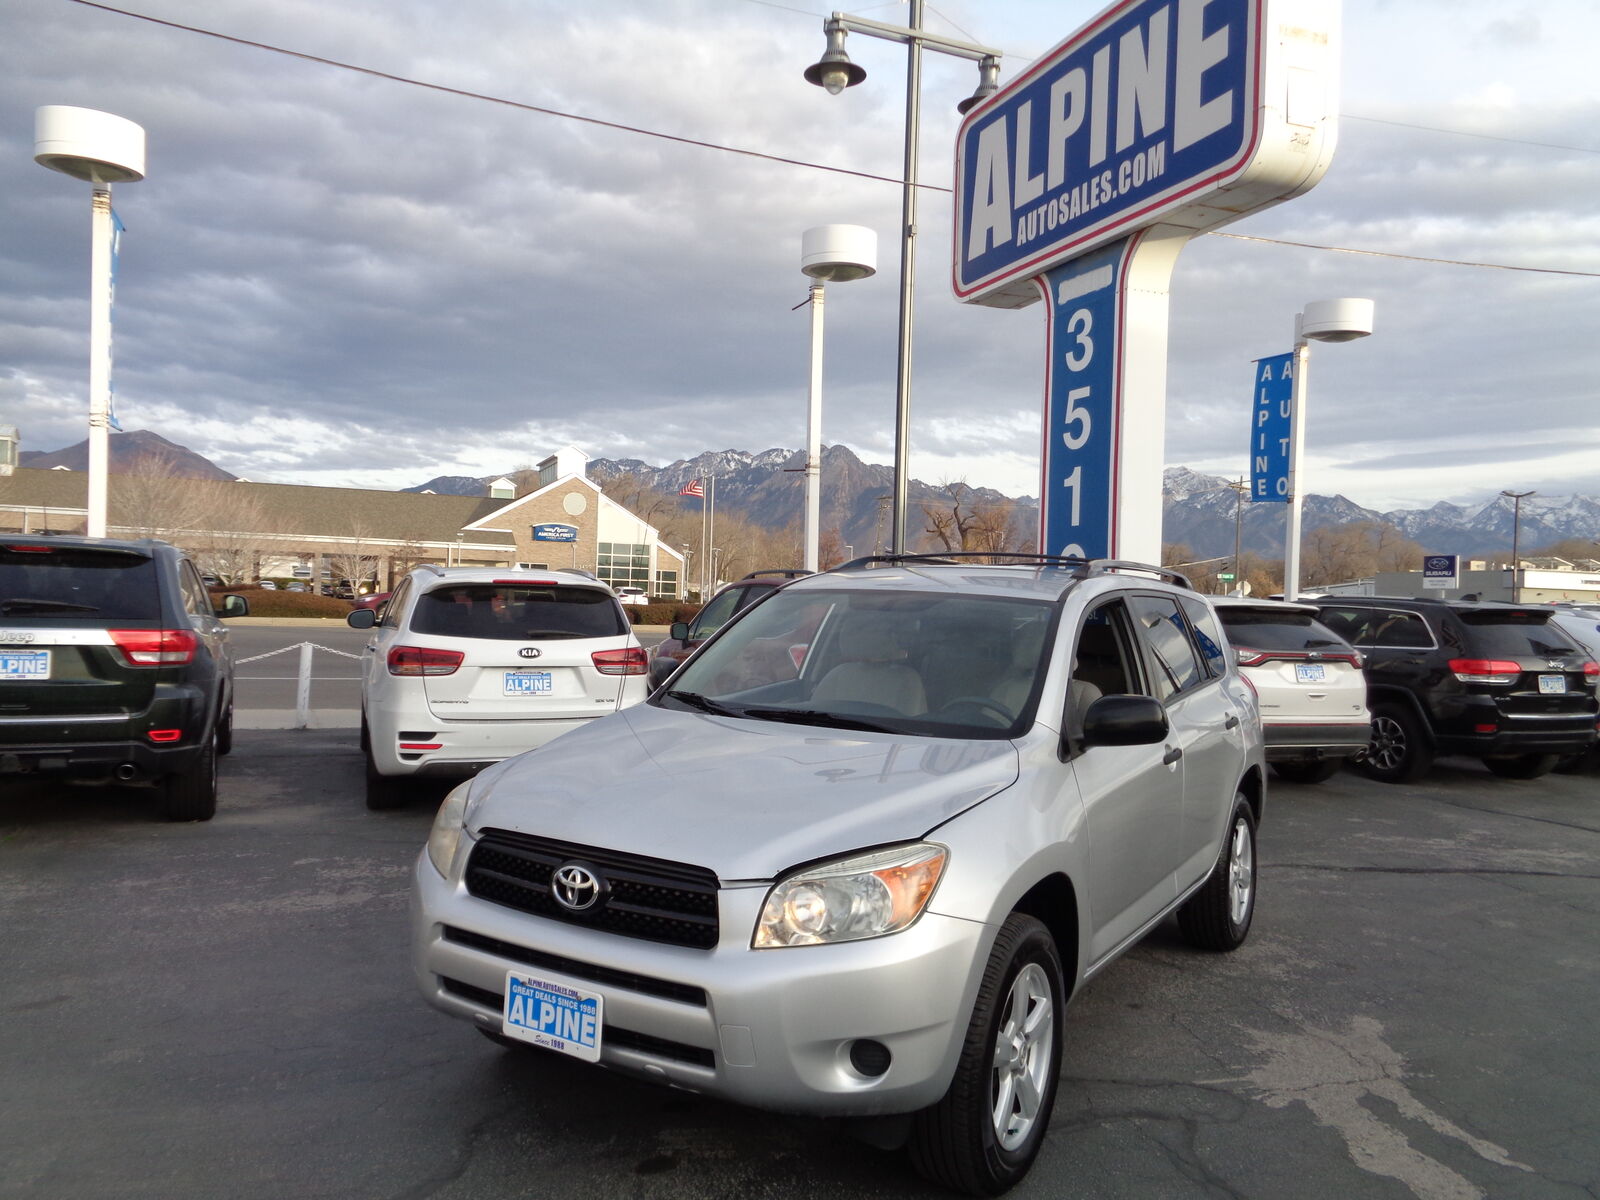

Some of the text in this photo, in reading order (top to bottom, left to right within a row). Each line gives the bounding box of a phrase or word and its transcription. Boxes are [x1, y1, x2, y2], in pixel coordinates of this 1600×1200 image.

[967, 0, 1233, 262] ALPINE
[1016, 140, 1166, 247] AUTOSALES.COM
[1255, 364, 1273, 496] ALPINE
[1276, 360, 1293, 496] AUTO
[0, 630, 35, 643] Jeep
[521, 649, 540, 657] KIA
[506, 679, 551, 691] ALPINE
[512, 984, 596, 1015] GREAT DEALS SINCE 1988
[509, 994, 596, 1048] ALPINE
[550, 1039, 565, 1050] 1988
